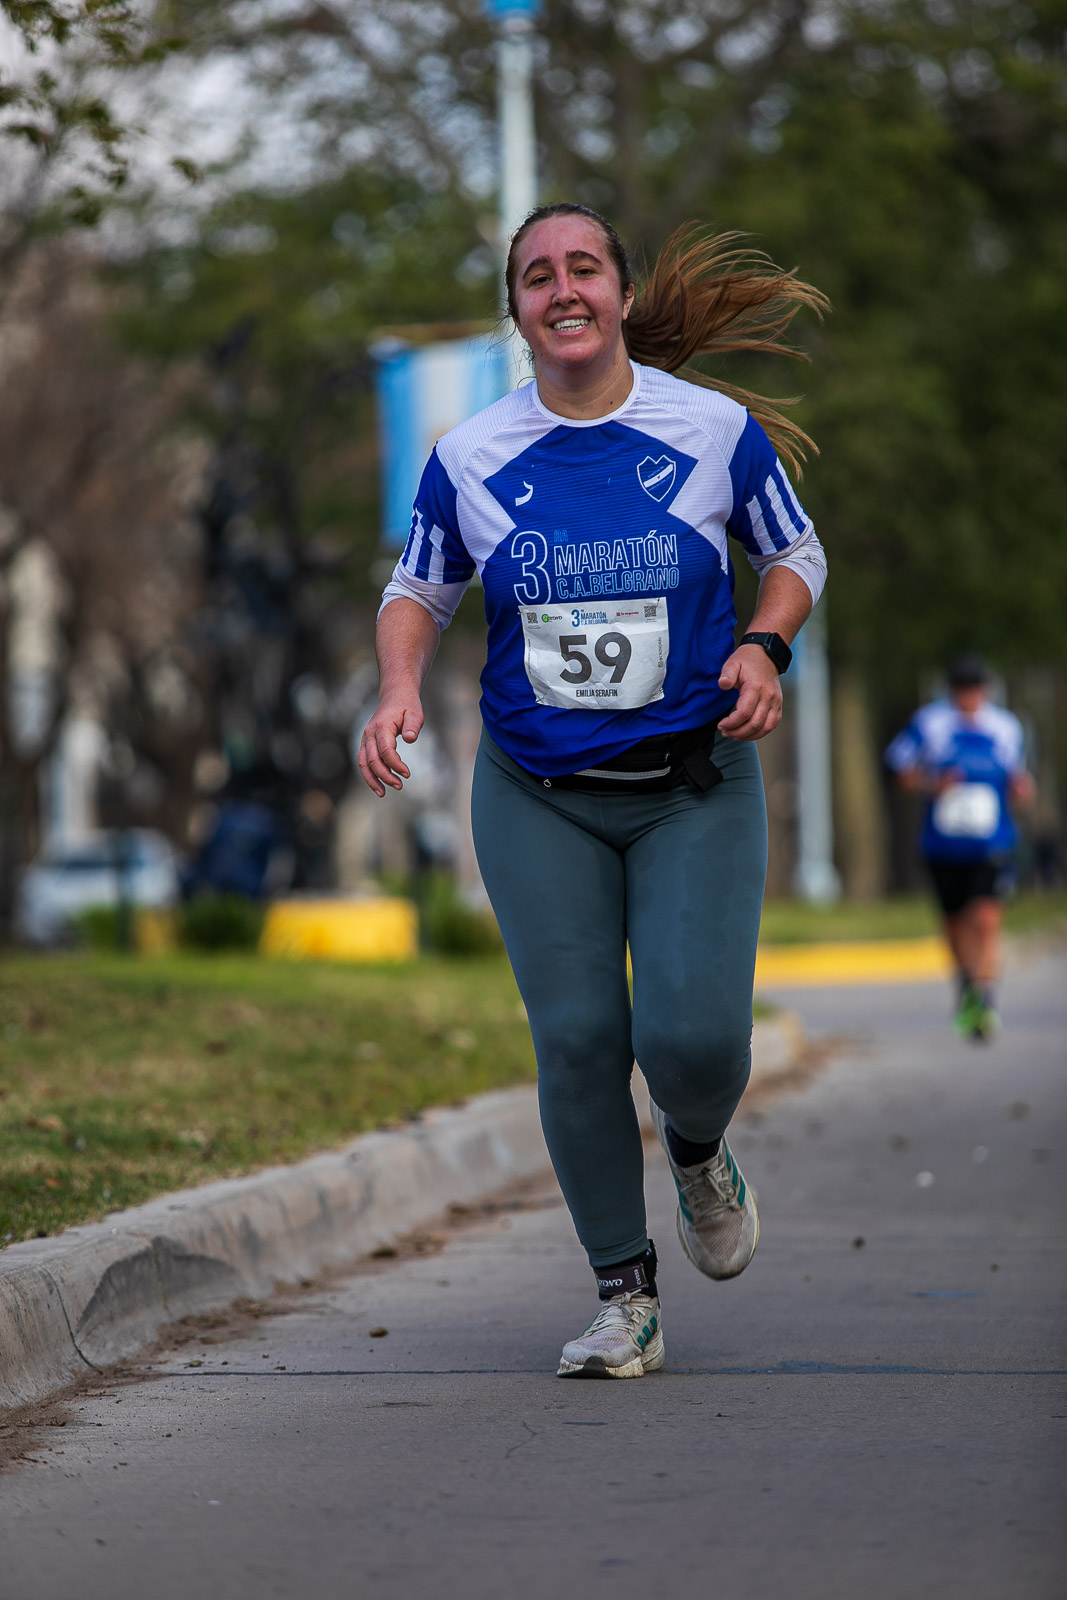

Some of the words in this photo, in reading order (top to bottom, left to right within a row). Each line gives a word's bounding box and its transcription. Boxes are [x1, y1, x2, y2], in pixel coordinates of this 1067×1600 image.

[511, 530, 551, 606] 3
[553, 530, 679, 576] MARATÓN
[571, 609, 580, 627] 3
[559, 631, 632, 685] 59
[575, 689, 595, 698] EMILIA
[595, 689, 618, 698] SERAFIN
